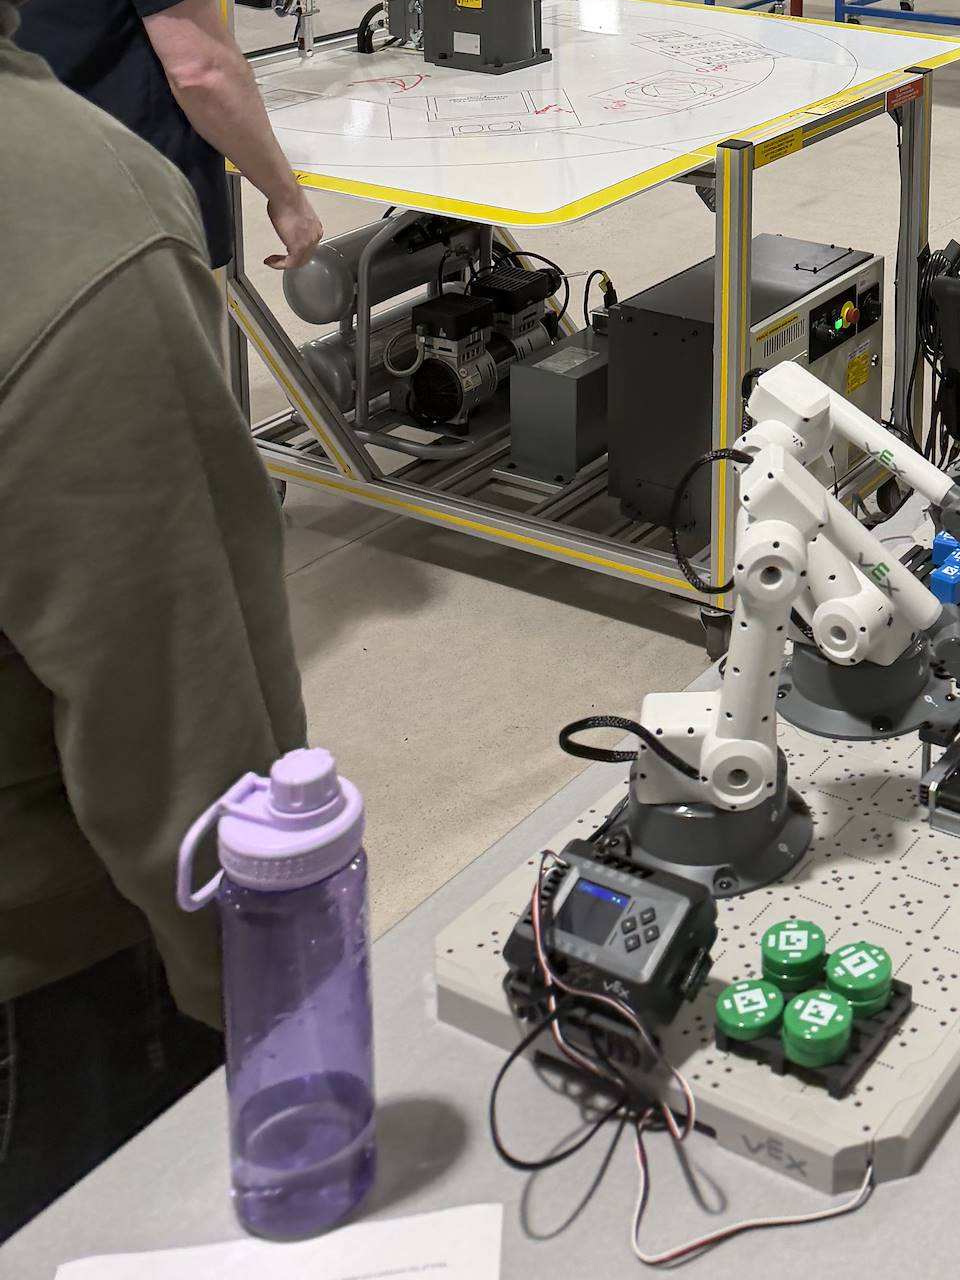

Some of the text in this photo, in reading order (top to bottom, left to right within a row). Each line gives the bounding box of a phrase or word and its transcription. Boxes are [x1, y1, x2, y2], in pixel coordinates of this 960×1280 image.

[864, 441, 907, 477] VEX
[857, 551, 900, 598] VEX
[603, 979, 630, 999] VEX
[741, 1134, 808, 1178] VEX
